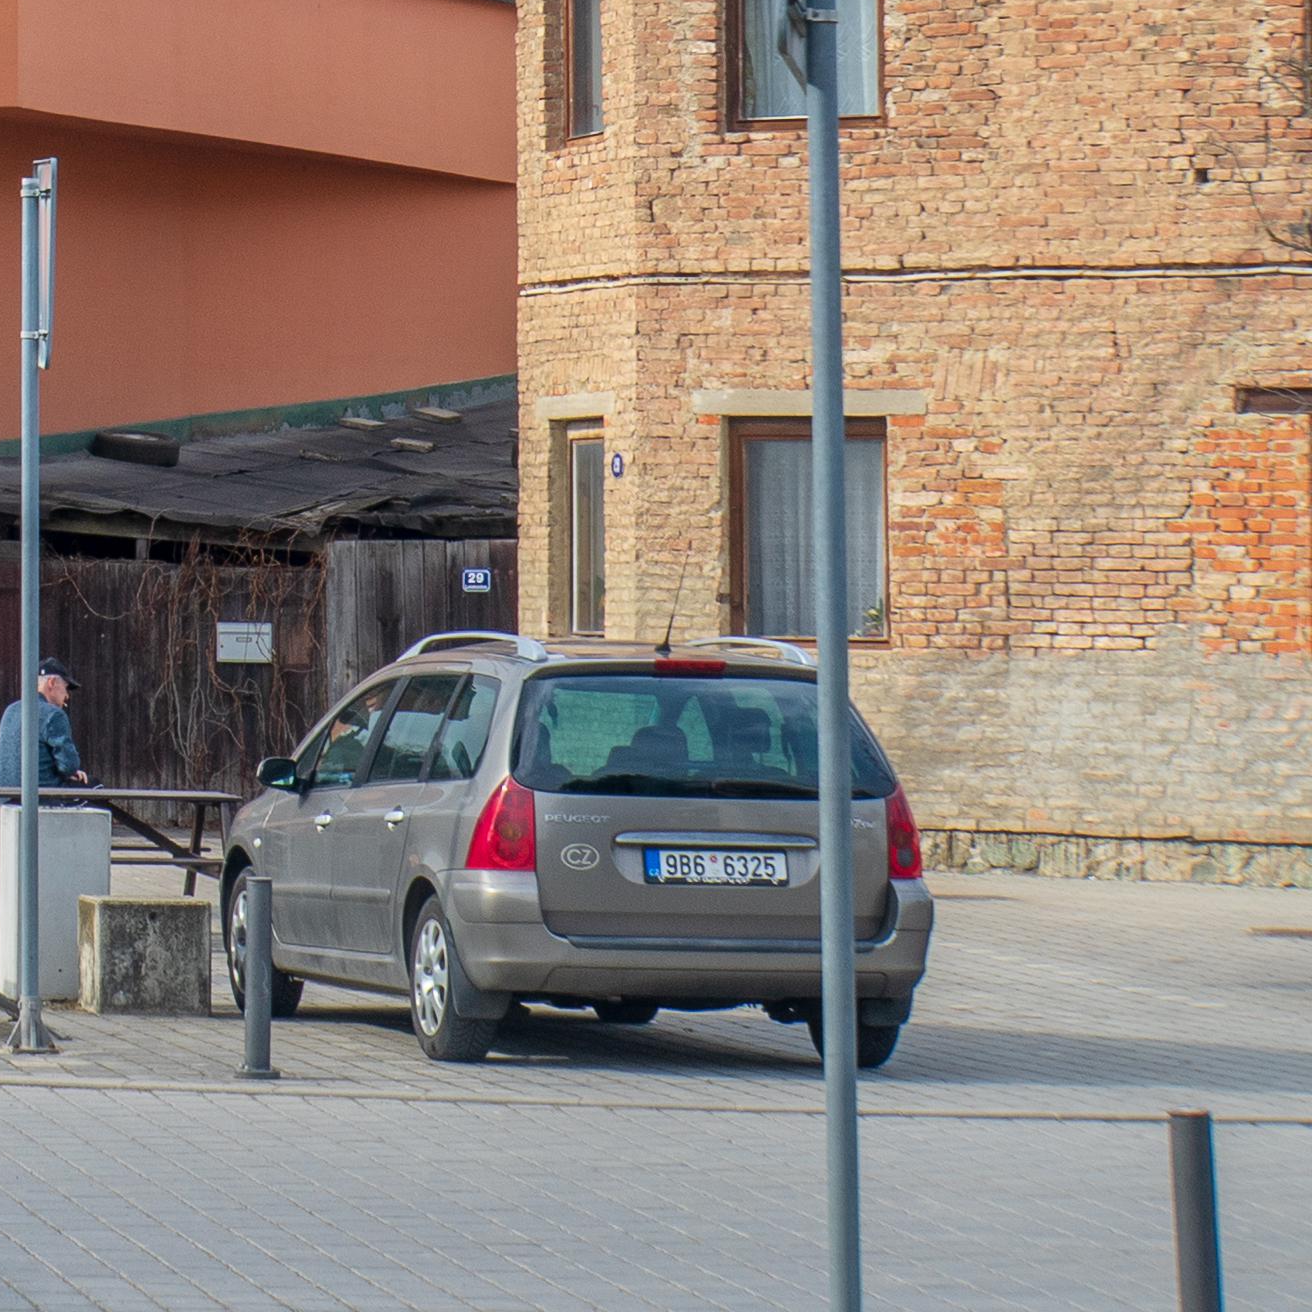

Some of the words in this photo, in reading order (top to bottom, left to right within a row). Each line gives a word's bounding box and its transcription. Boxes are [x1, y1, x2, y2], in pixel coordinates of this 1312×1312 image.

[468, 572, 484, 584] 29
[544, 813, 610, 823] PEUGEOT
[566, 848, 593, 865] CZ
[665, 854, 706, 876] 9B6
[723, 855, 776, 878] 6325
